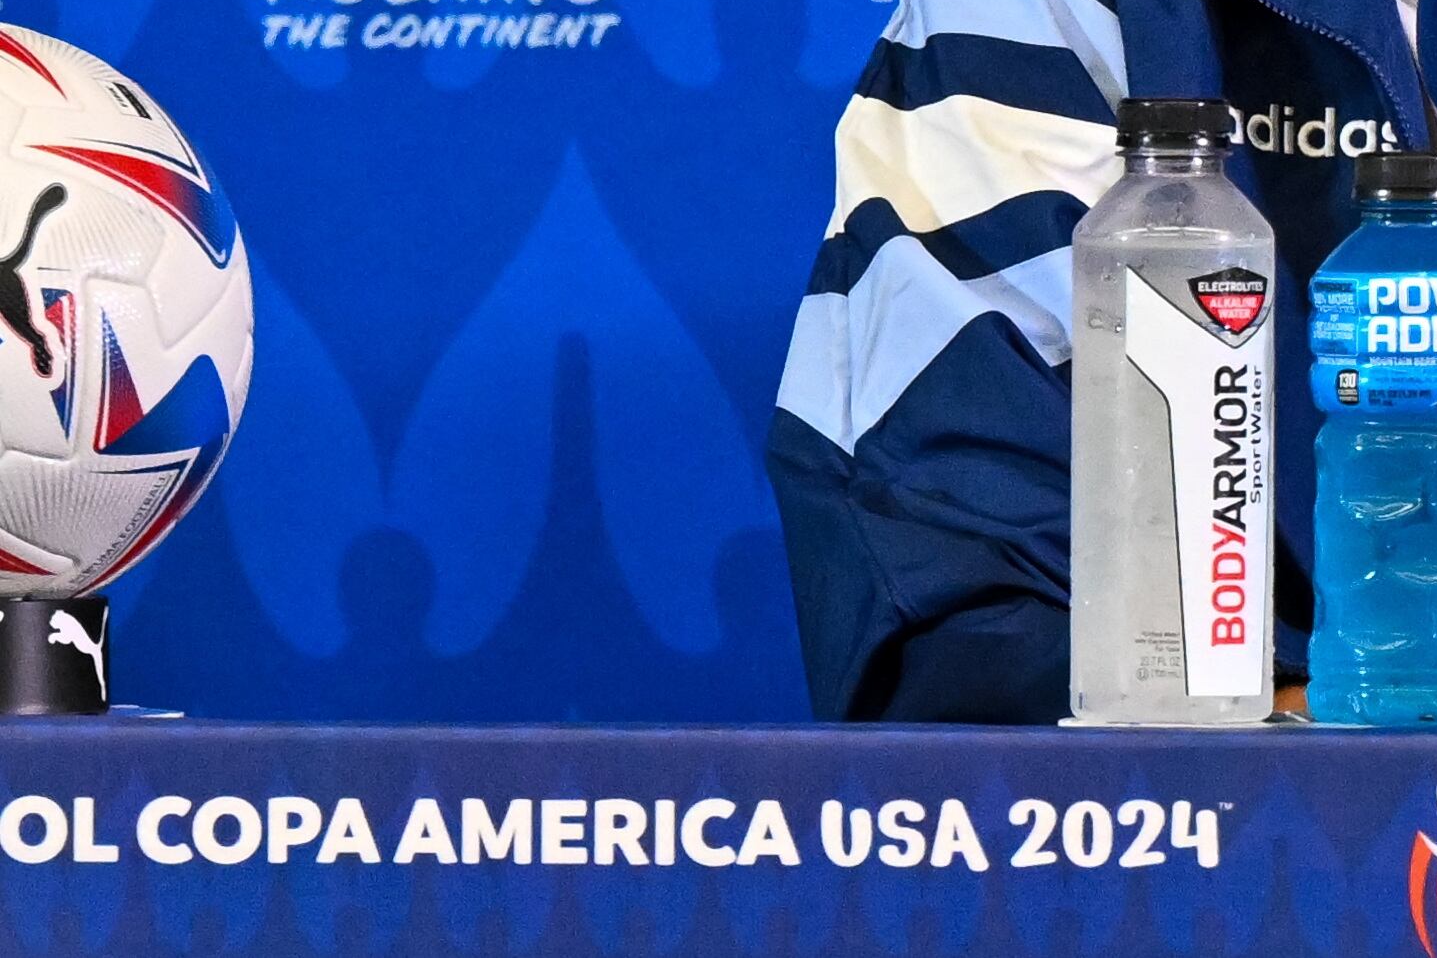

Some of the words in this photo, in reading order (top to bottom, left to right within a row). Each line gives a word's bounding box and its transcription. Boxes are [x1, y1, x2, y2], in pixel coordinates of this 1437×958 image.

[262, 14, 350, 48] THE
[362, 13, 621, 49] CONTINENT
[1339, 373, 1357, 388] 130
[1212, 365, 1248, 647] BODYARMOR
[137, 796, 381, 864] COPA
[393, 798, 800, 866] AMERICA
[821, 799, 989, 871] USA
[1008, 799, 1220, 868] 2024
